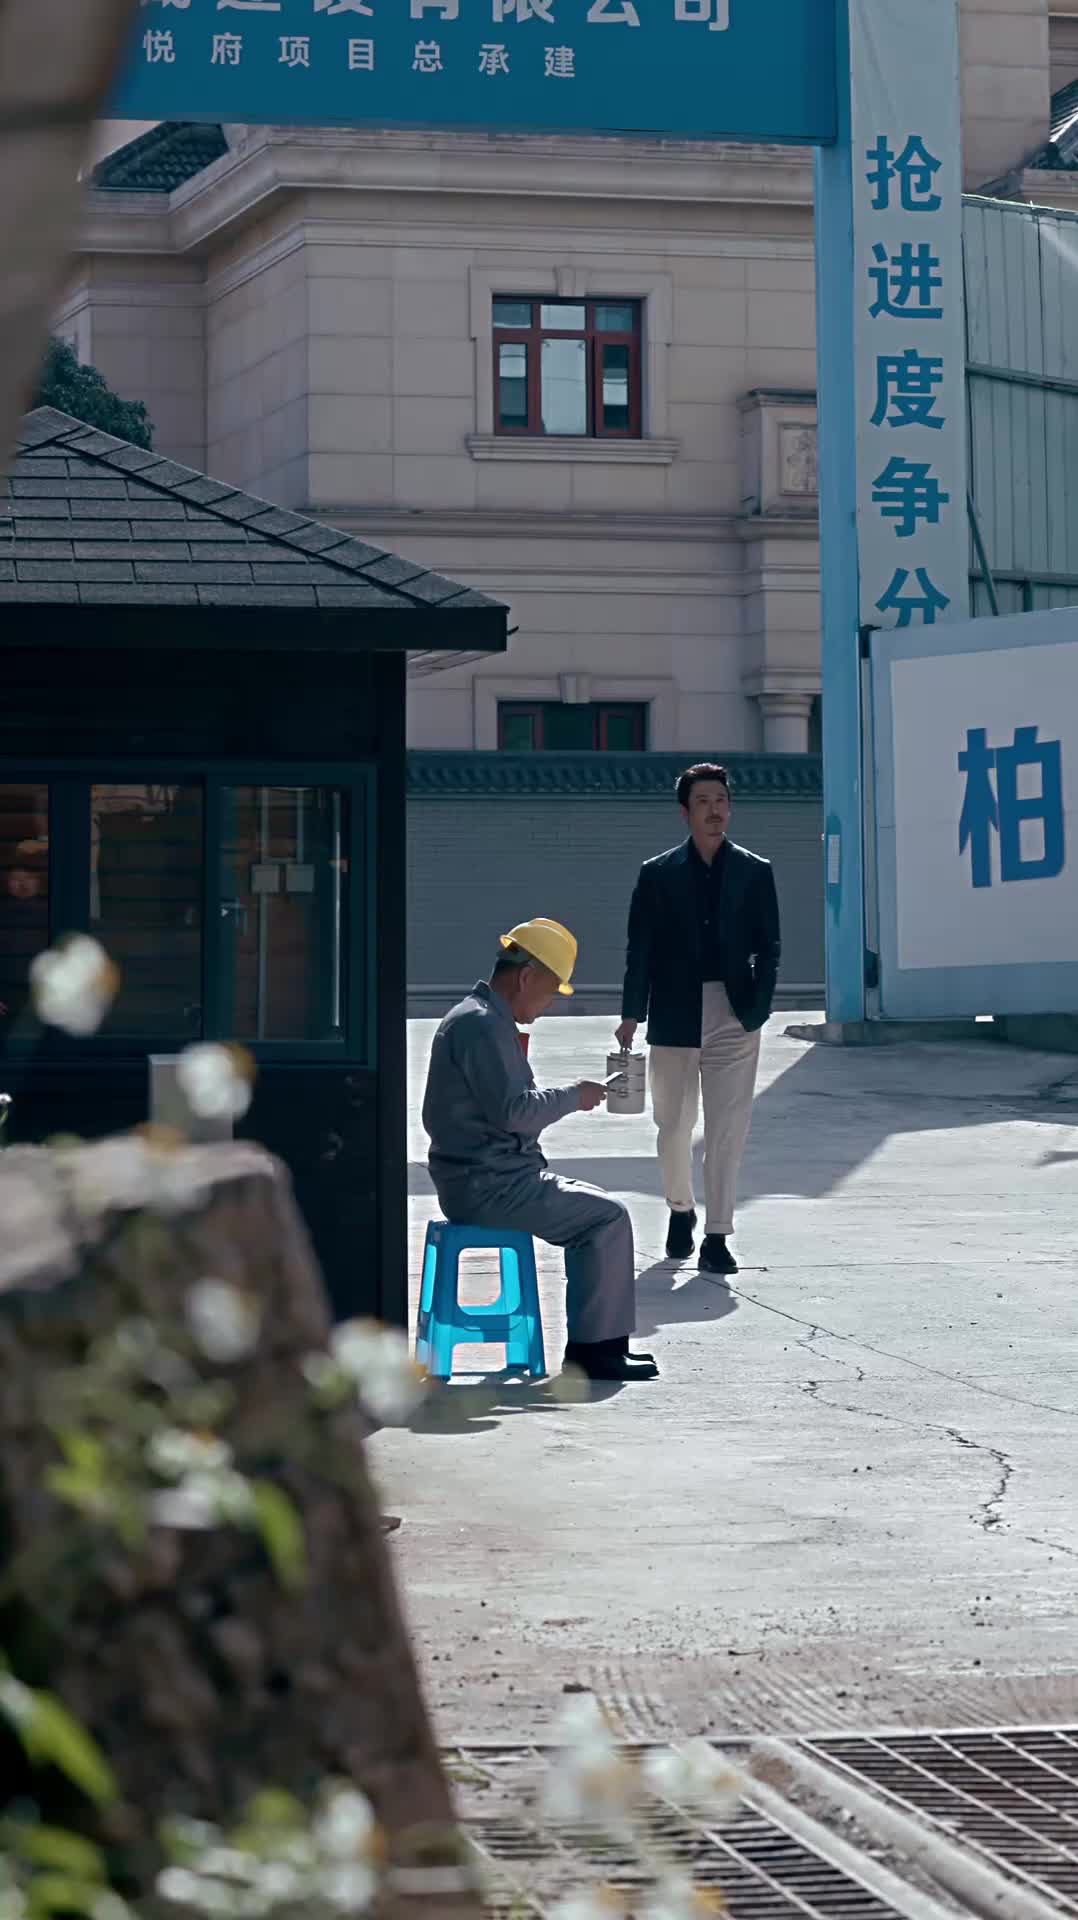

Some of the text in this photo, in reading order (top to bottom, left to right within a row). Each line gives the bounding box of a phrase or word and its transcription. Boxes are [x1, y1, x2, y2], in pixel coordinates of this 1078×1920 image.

[143, 29, 576, 77] 悦府项目总承建
[866, 135, 950, 628] 抢进度争分
[958, 725, 1065, 889] 柏
